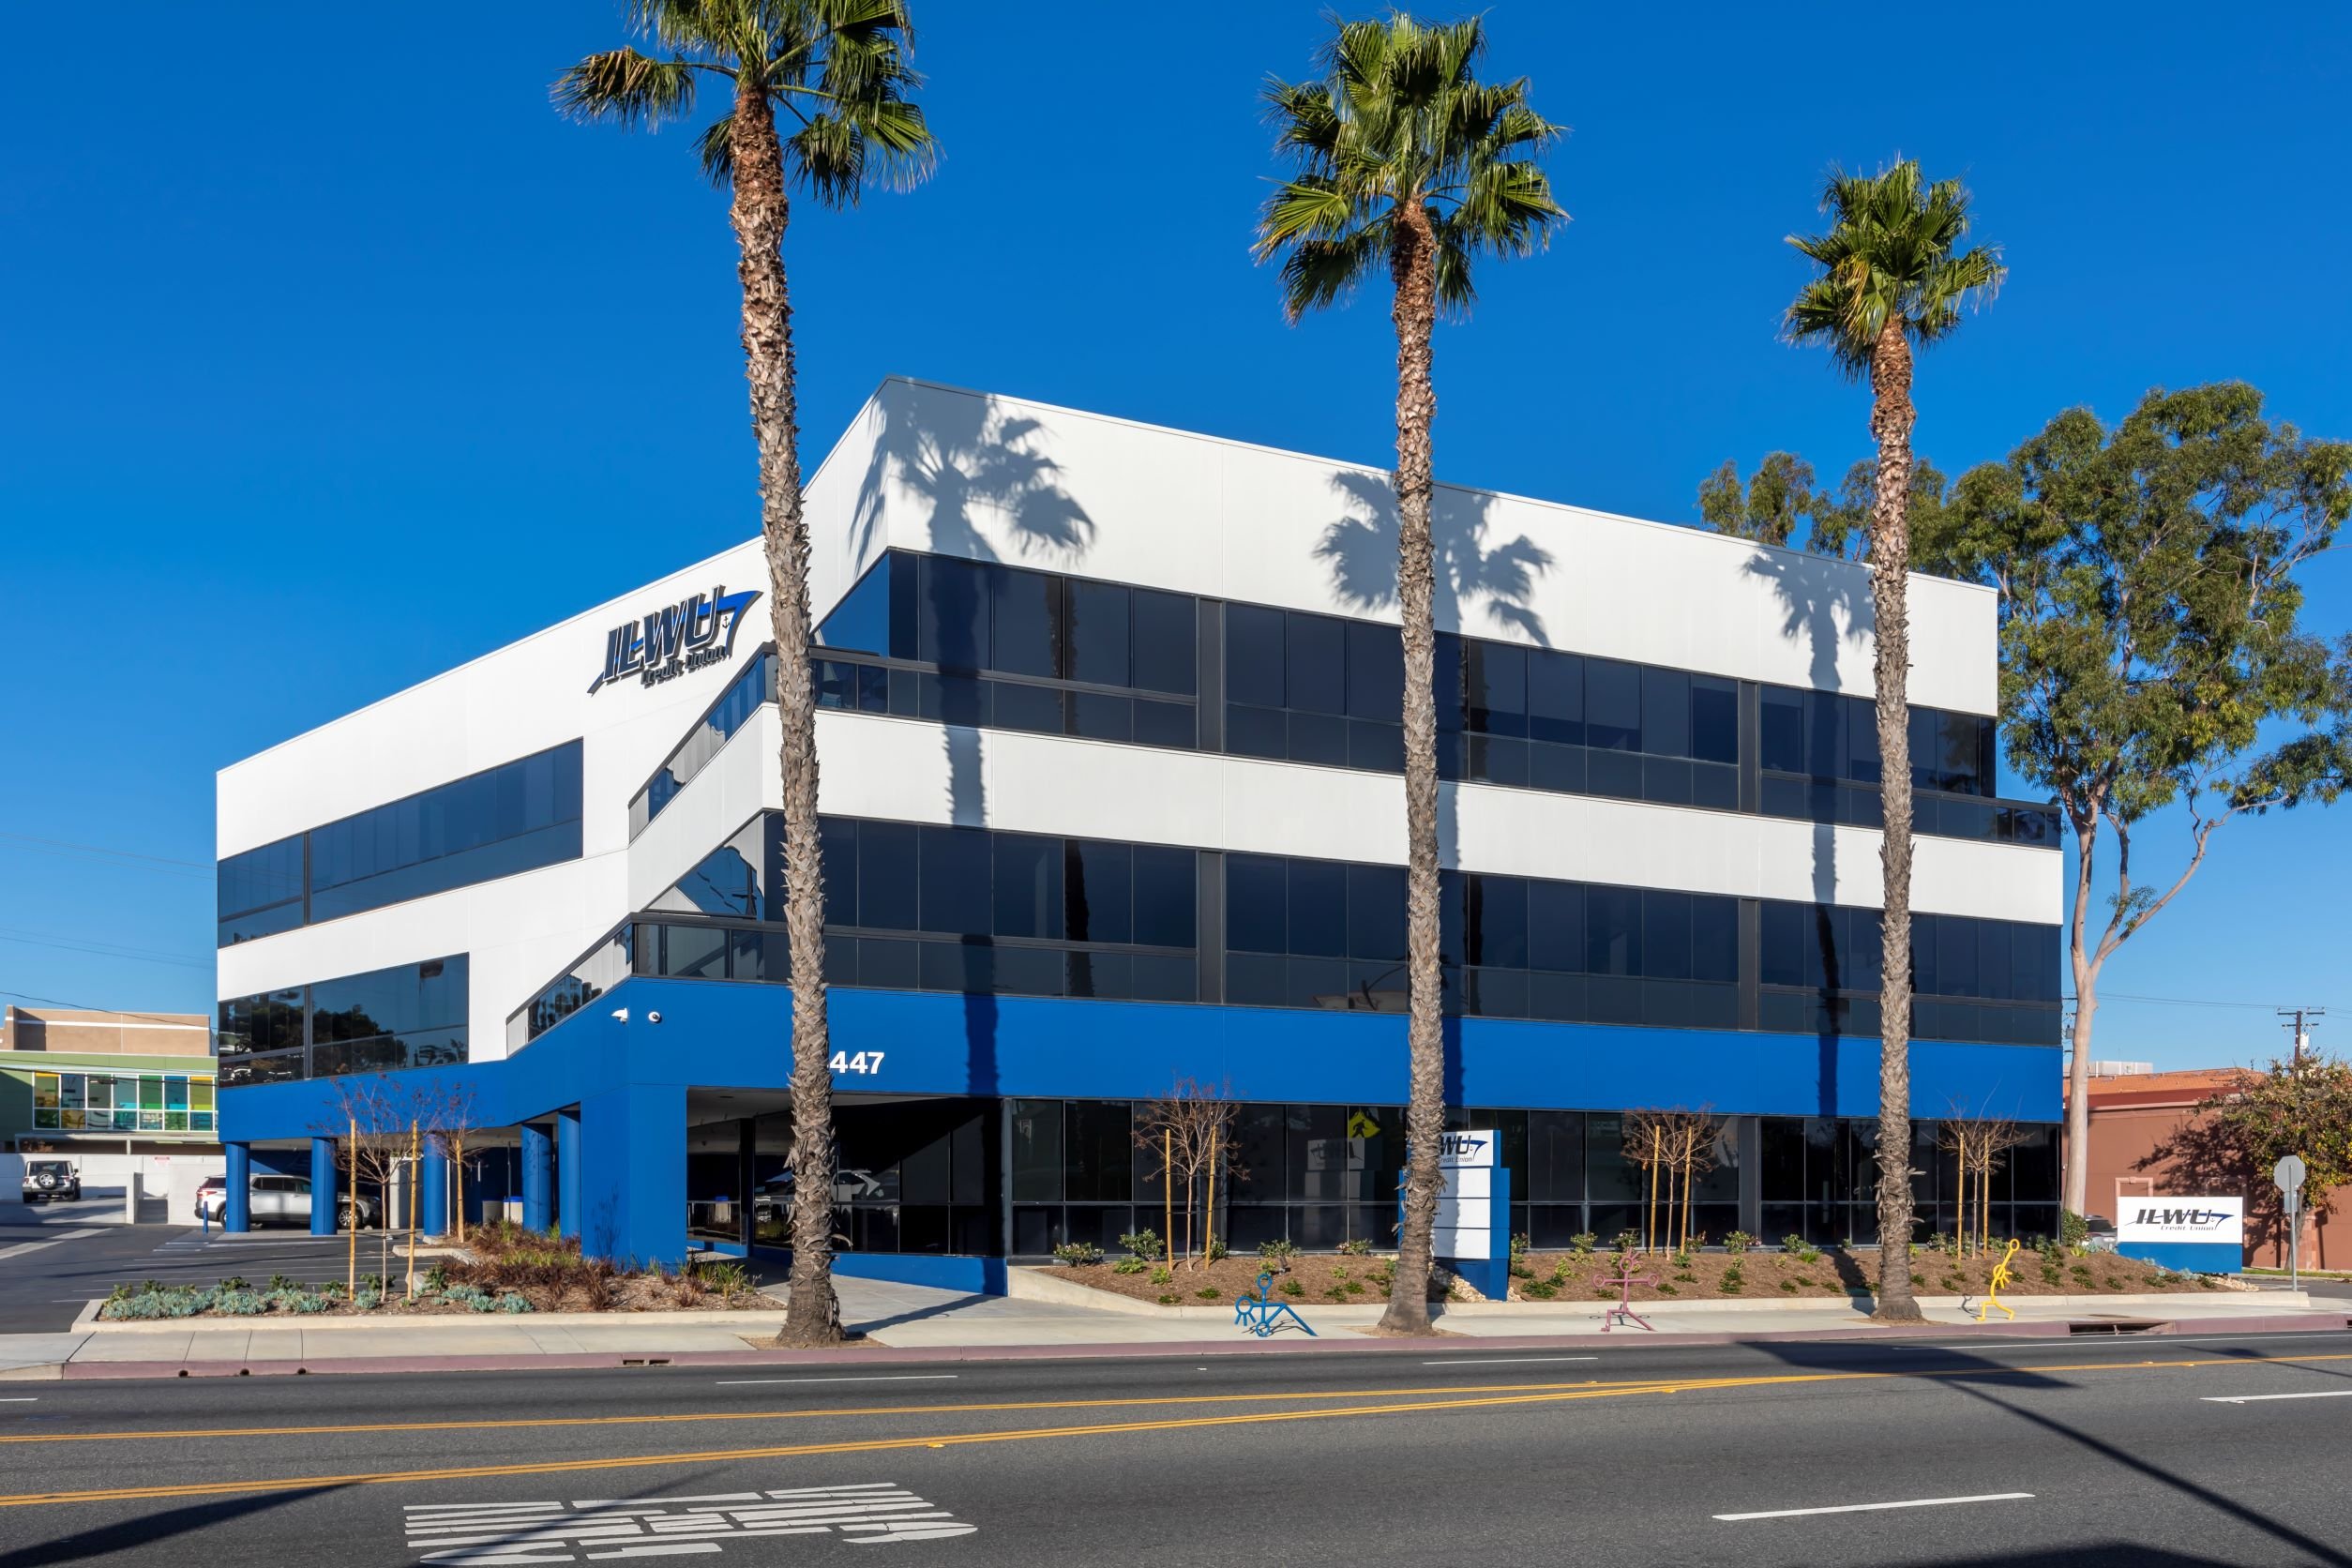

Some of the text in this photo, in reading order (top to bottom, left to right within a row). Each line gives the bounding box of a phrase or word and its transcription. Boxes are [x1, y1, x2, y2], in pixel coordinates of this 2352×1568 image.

[602, 584, 726, 684] ILWU
[641, 658, 683, 687] Credit
[1440, 1135, 1471, 1155] WU
[2136, 1209, 2211, 1224] ILWU
